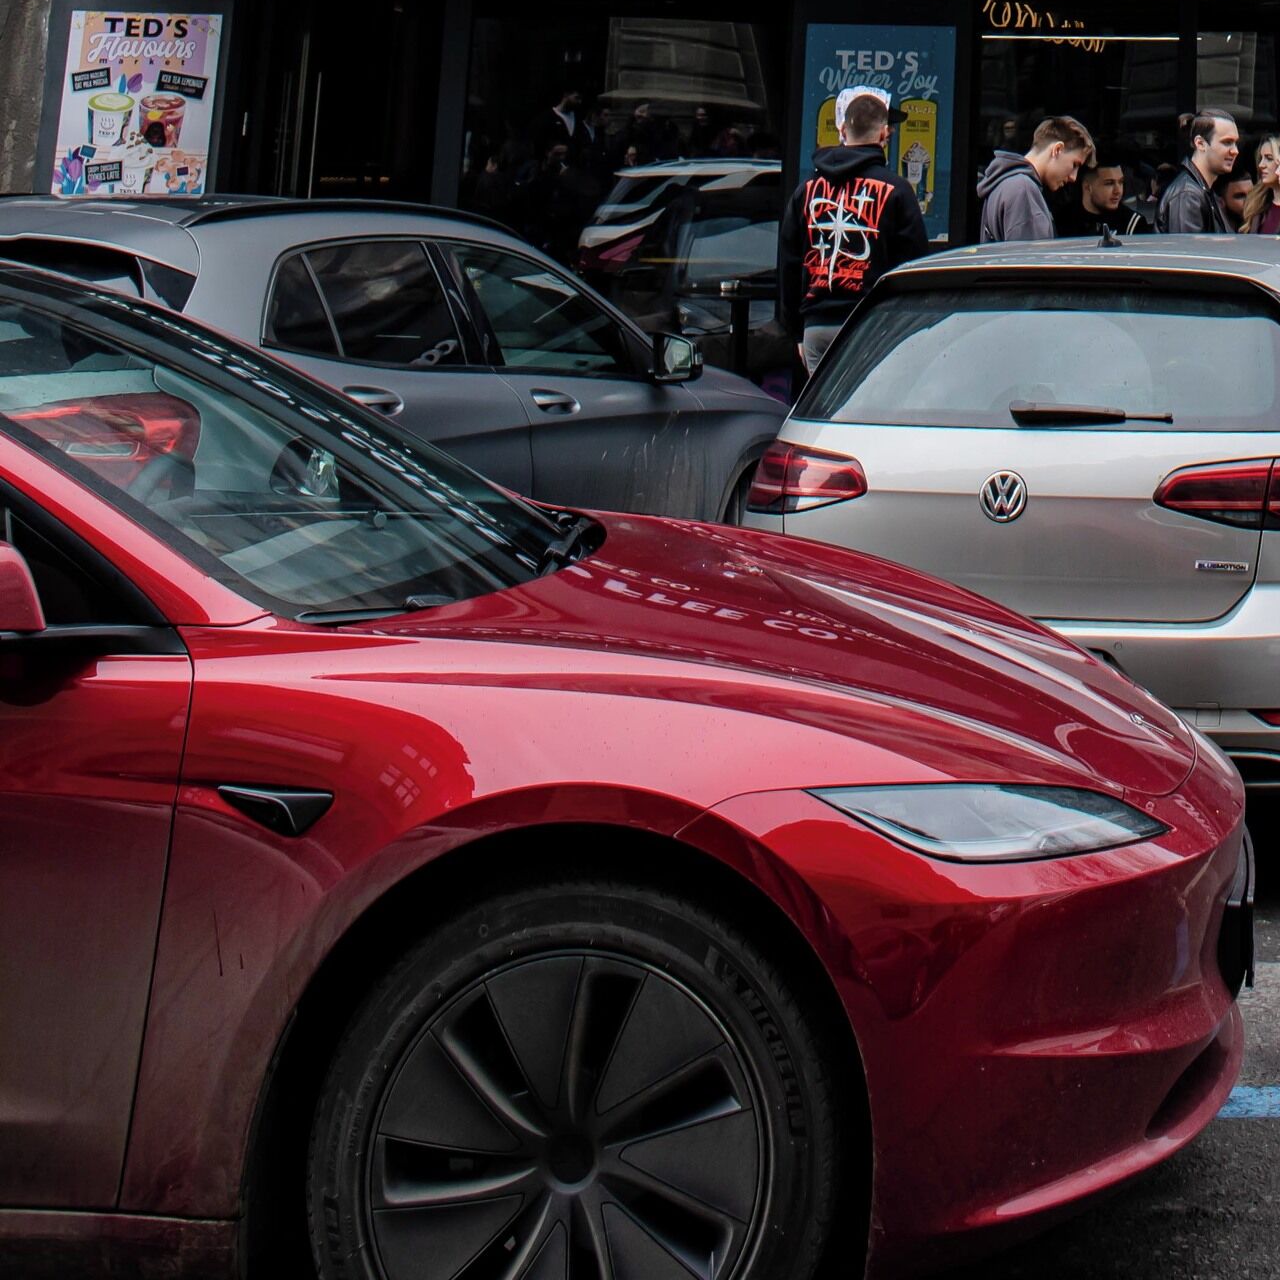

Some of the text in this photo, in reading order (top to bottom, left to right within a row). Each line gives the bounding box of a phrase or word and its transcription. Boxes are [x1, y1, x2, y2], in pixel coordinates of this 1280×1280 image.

[104, 17, 189, 39] TED'S
[87, 31, 197, 63] Flavours
[835, 50, 919, 71] TED'S
[818, 63, 940, 100] Winter Joy
[1198, 562, 1246, 570] BLUEMOTION
